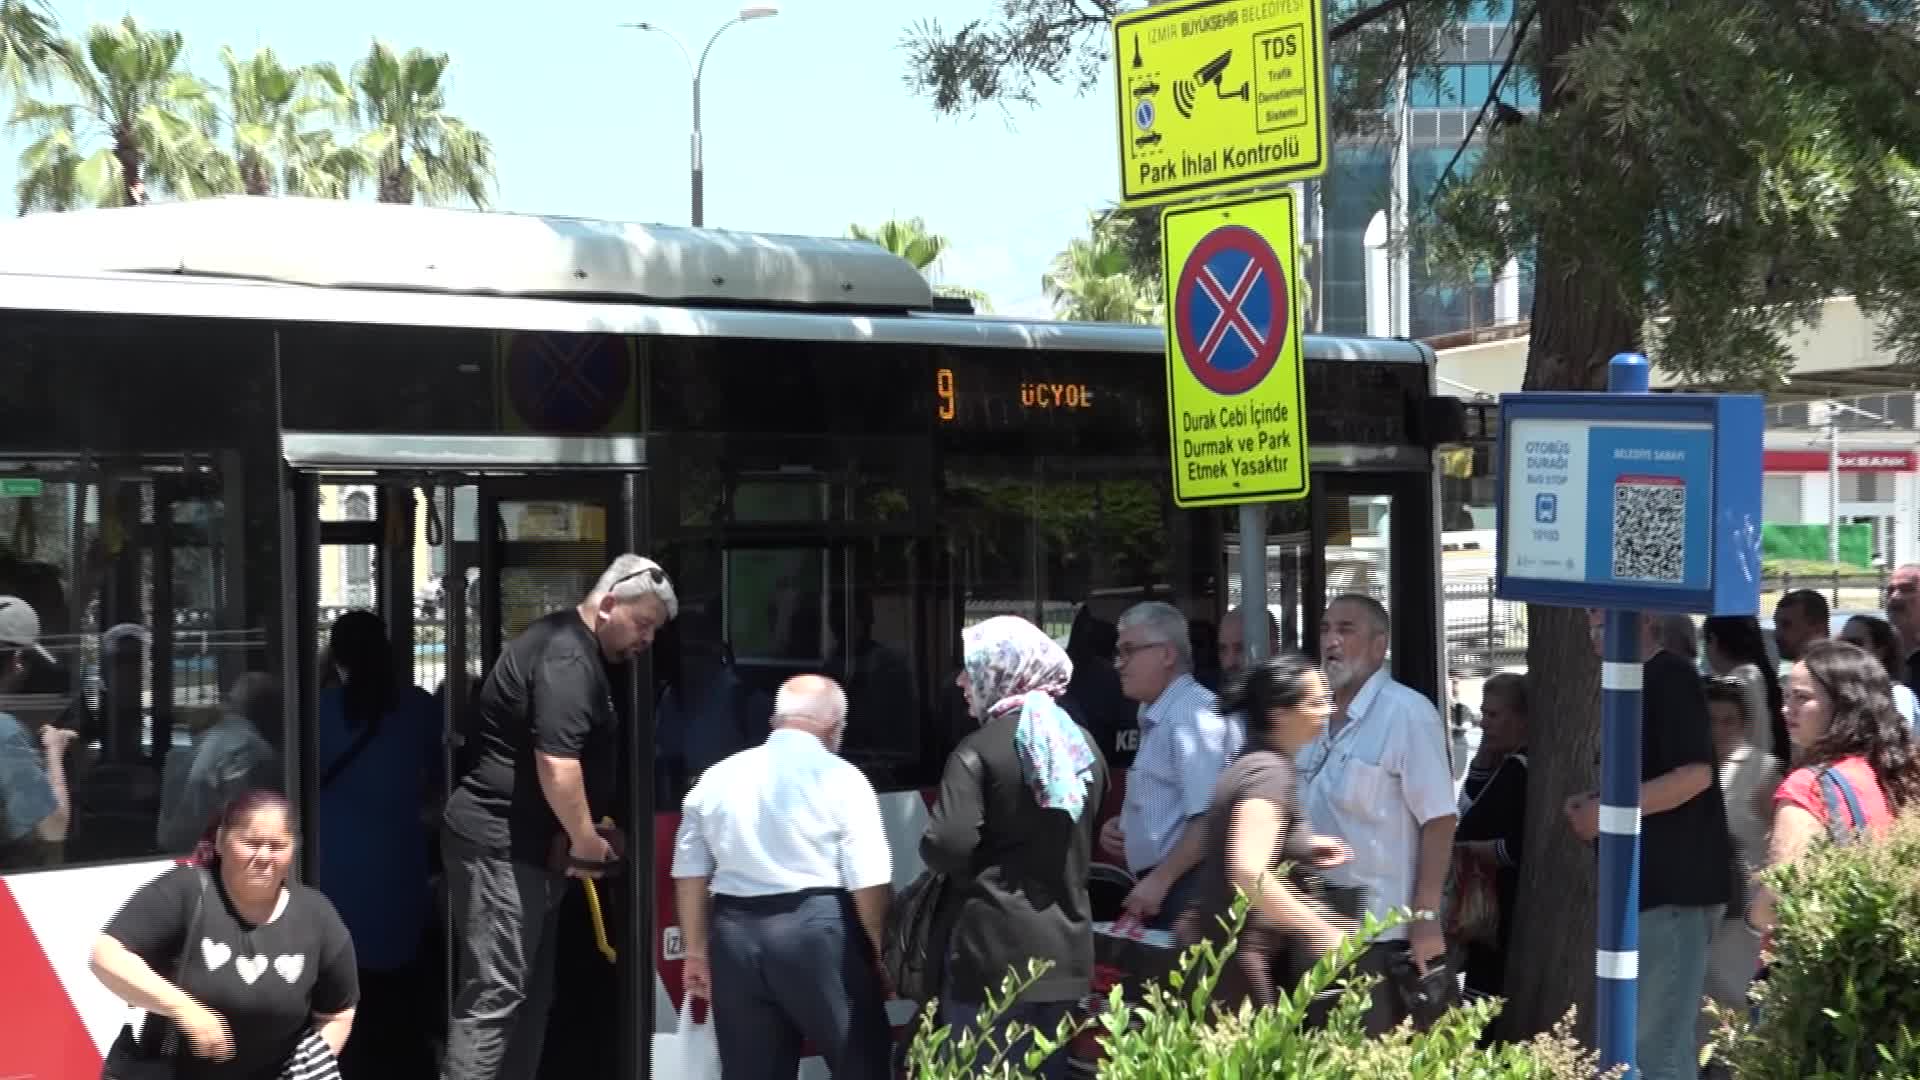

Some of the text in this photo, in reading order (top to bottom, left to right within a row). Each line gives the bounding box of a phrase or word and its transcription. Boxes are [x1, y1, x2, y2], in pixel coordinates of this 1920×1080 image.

[1261, 34, 1297, 61] TDS
[1268, 68, 1292, 82] Trafik
[1266, 107, 1298, 122] Sistemi
[1140, 137, 1300, 185] Park İhlal Kontrolü
[937, 368, 955, 420] 9
[1183, 400, 1288, 432] Durak Cebi İçinde
[1184, 429, 1291, 458] Durmak ve Park
[1525, 440, 1570, 455] OTOBÜS
[1188, 455, 1288, 481] Etmek Yasaktır
